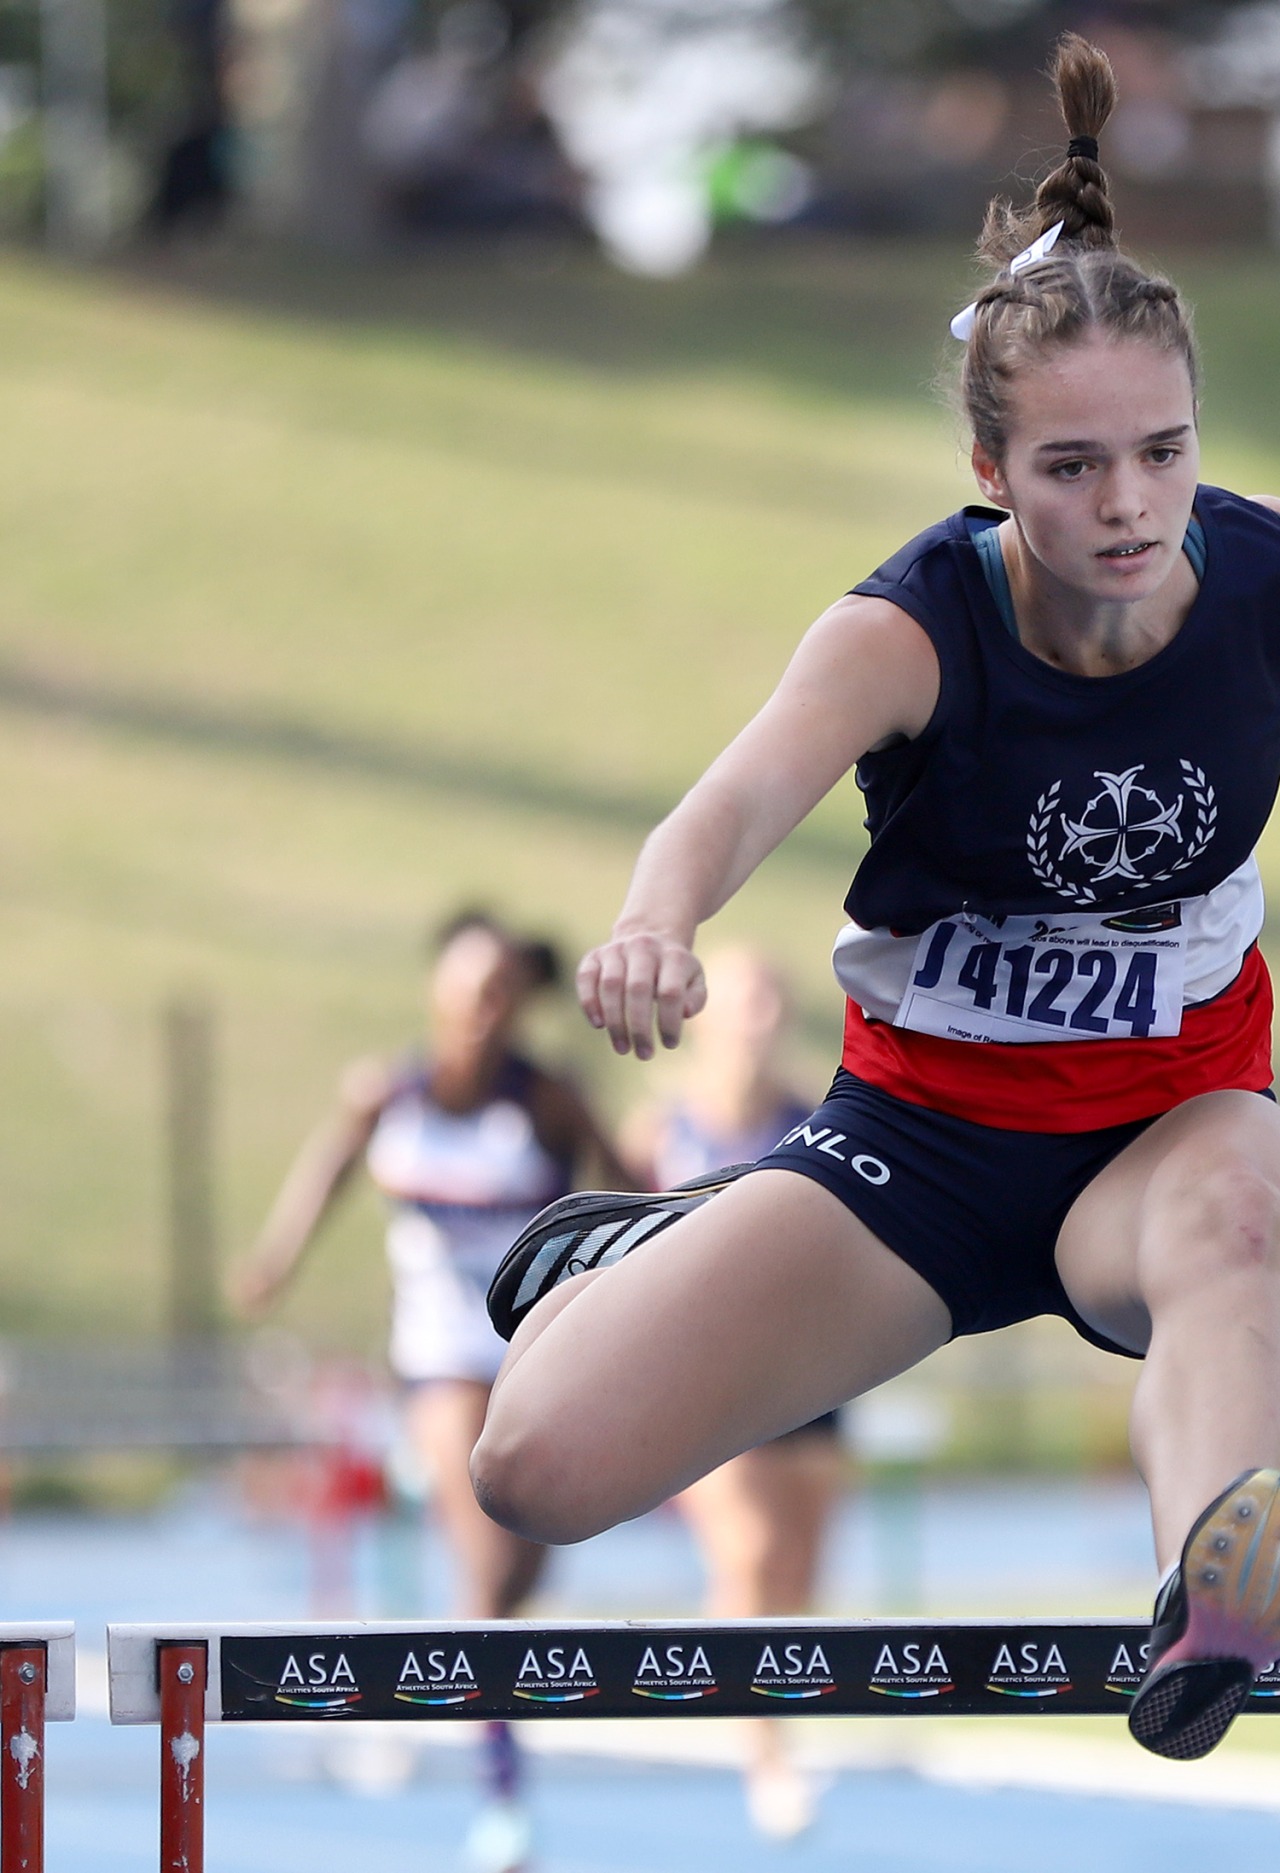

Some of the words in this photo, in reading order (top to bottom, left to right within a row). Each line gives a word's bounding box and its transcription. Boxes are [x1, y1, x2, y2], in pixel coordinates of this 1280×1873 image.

[1048, 935, 1075, 945] above
[1076, 938, 1091, 946] will
[1091, 938, 1109, 948] lead
[1111, 939, 1119, 947] to
[1120, 939, 1180, 949] disqualification
[913, 921, 957, 989] J
[958, 942, 1157, 1038] 41224
[947, 1025, 972, 1039] Image
[774, 1124, 891, 1186] NLO
[280, 1654, 355, 1684] ASA
[400, 1651, 474, 1681] ASA
[519, 1648, 593, 1679] ASA
[638, 1647, 712, 1676] ASA
[756, 1645, 830, 1675] ASA
[874, 1645, 948, 1674] ASA
[993, 1645, 1066, 1673] ASA
[1111, 1644, 1150, 1673] AS
